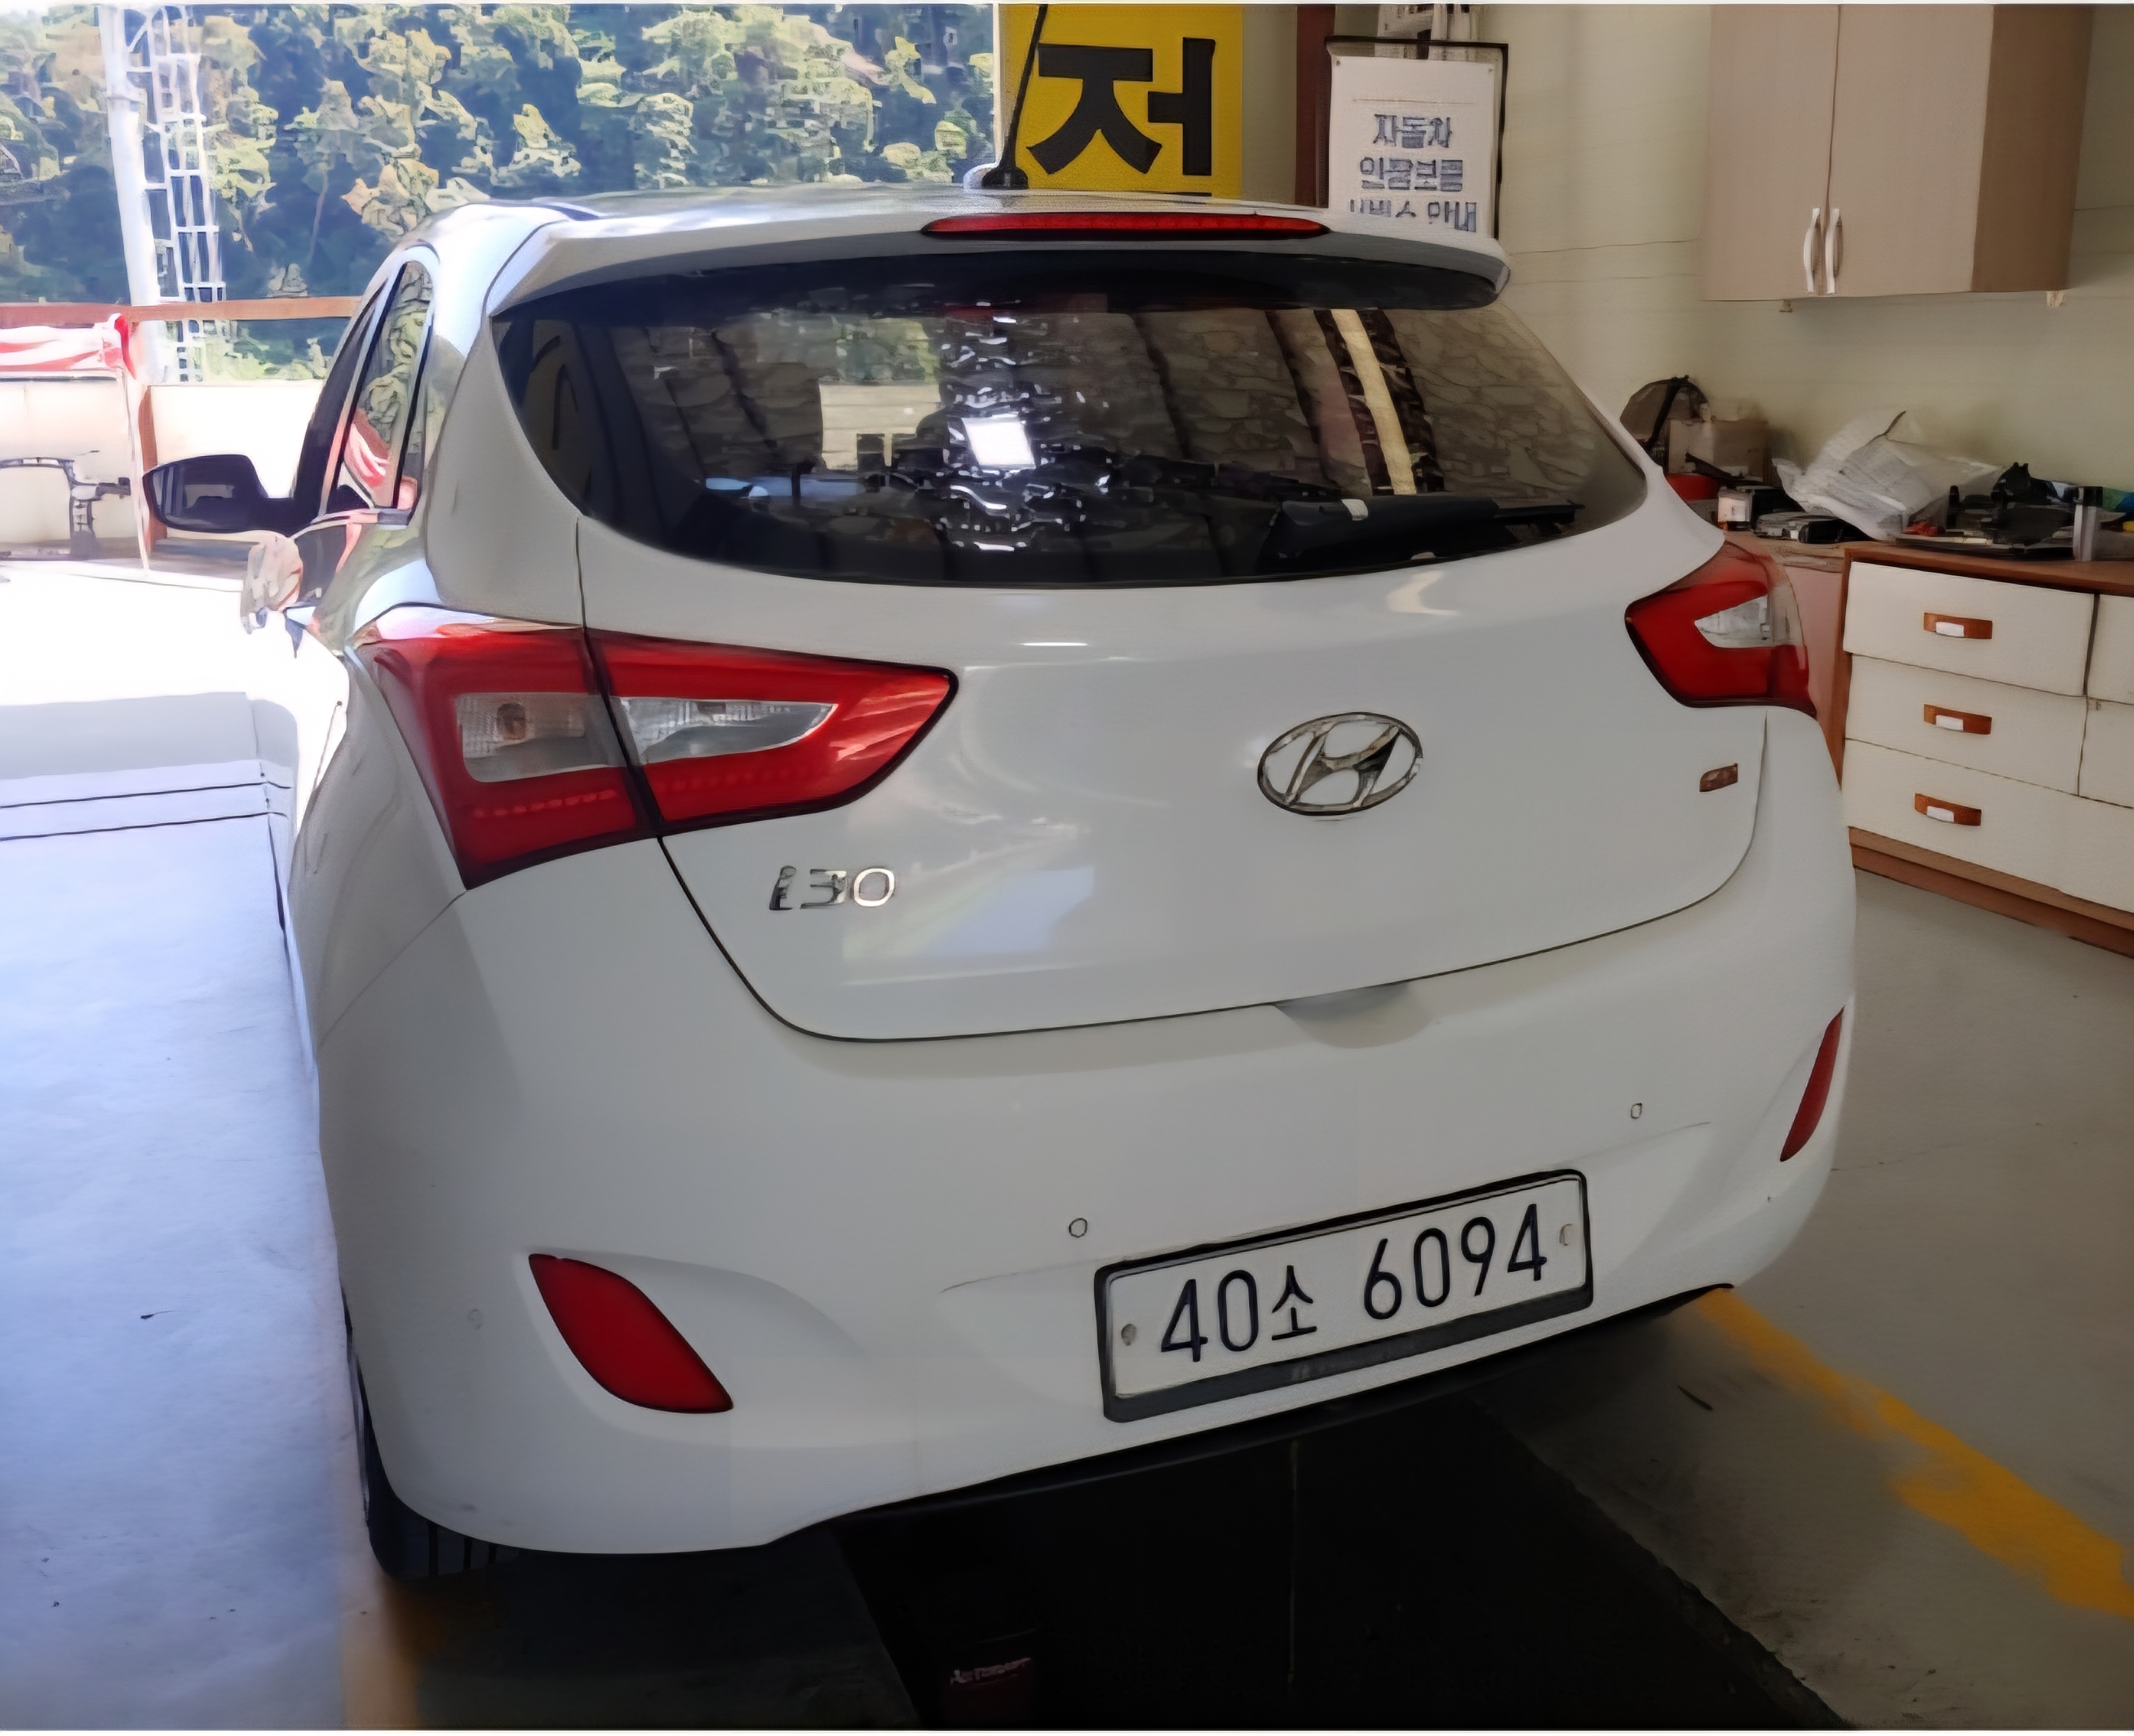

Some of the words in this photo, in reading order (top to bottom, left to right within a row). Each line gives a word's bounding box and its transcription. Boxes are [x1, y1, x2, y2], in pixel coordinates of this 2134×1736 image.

[1372, 113, 1453, 148] 자동차
[768, 865, 896, 911] i30
[1160, 1264, 1317, 1362] 40소
[1363, 1202, 1547, 1320] 6094
